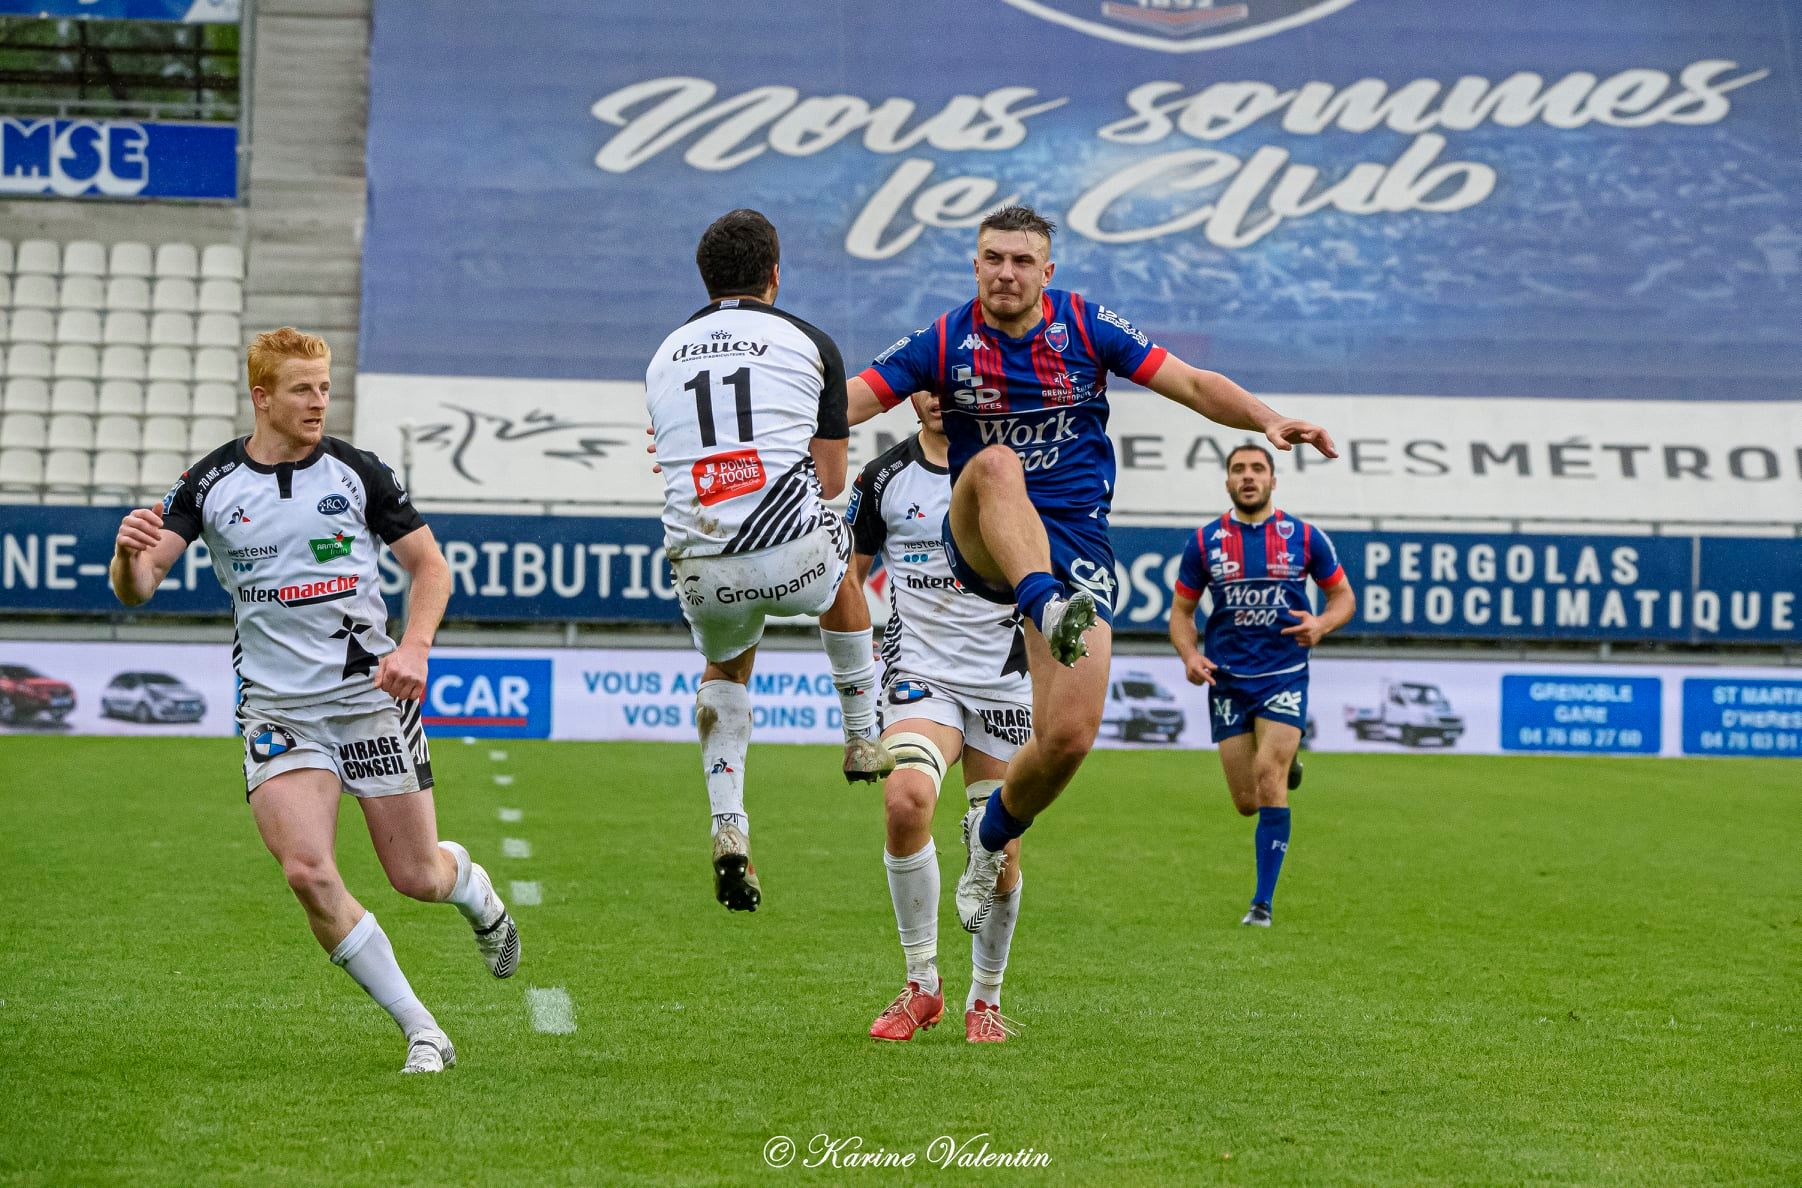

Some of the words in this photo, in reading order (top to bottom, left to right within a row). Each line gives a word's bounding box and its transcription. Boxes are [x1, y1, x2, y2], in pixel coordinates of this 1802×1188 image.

[591, 76, 1070, 173] Nous
[1098, 59, 1771, 144] sommes
[845, 158, 1018, 260] le
[1066, 133, 1496, 248] Club
[672, 340, 768, 361] d'aucy
[684, 367, 754, 448] 11
[953, 388, 1001, 404] SD
[975, 410, 1079, 447] Work
[205, 466, 220, 482] ANS
[719, 466, 760, 485] TOQUE
[720, 457, 758, 472] POULE
[326, 498, 348, 510] RCV
[1211, 562, 1240, 577] SD
[1364, 542, 1640, 586] PERGOLAS
[716, 562, 826, 604] Groupama
[1225, 585, 1290, 608] Work
[1234, 609, 1278, 626] 2000
[1364, 585, 1796, 634] BIOCLIMATIQUE
[583, 671, 663, 695] VOUS
[1529, 681, 1633, 703] GRENOBLE
[430, 674, 530, 716] CAR
[624, 705, 681, 727] VOS
[339, 736, 402, 761] VIRAGE
[342, 754, 407, 780] CONSEIL
